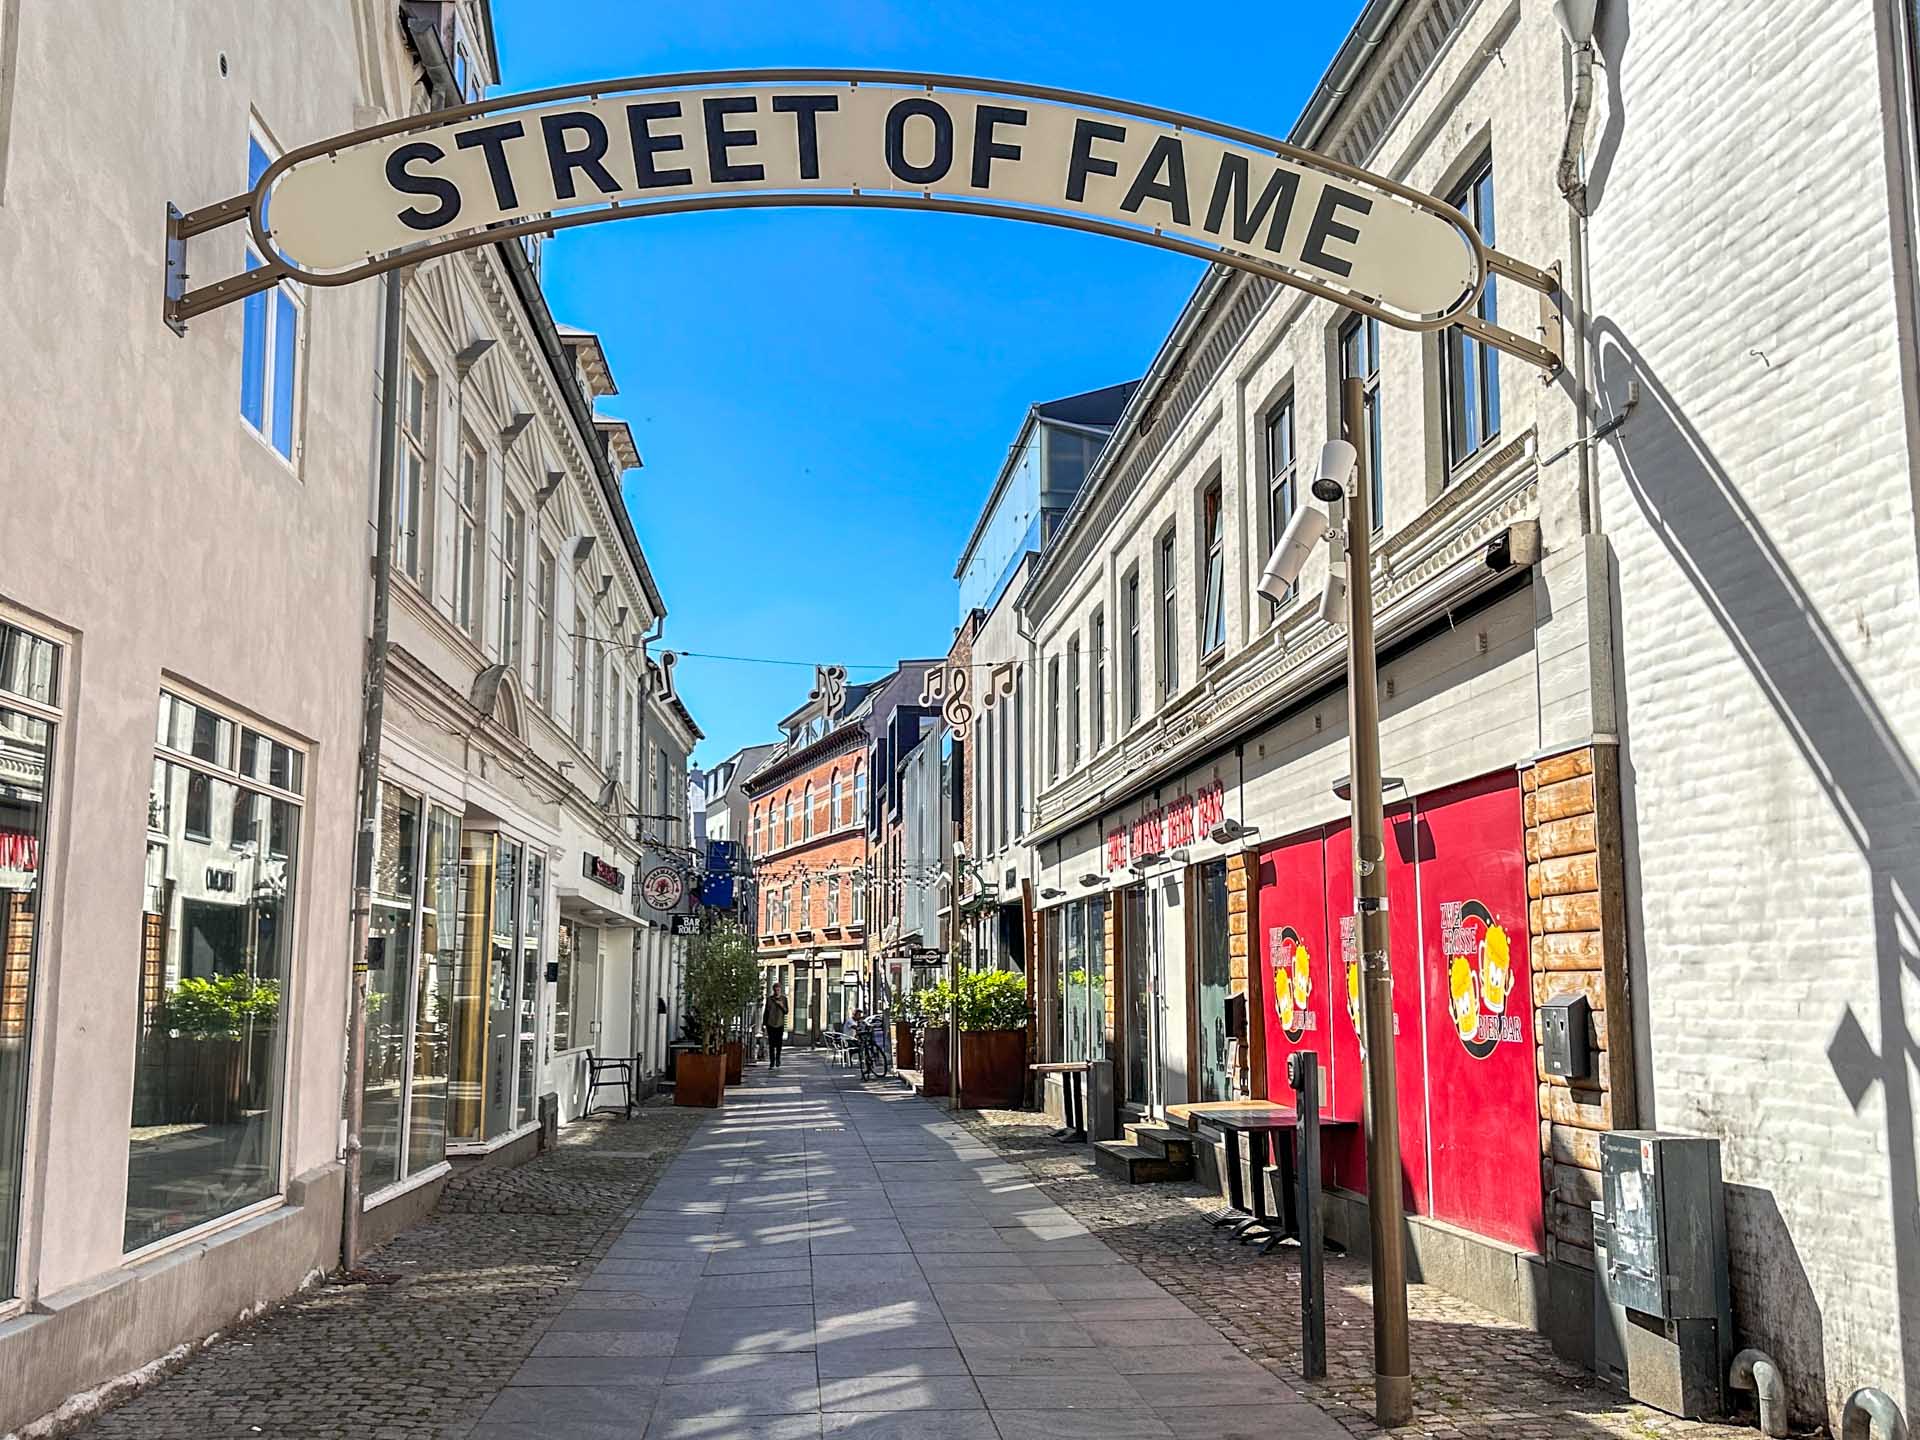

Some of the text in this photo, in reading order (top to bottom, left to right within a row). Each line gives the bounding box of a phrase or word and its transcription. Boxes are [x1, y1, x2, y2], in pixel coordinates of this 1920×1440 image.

[386, 95, 1373, 277] STREET OF FAME
[682, 917, 700, 927] BAR
[1440, 902, 1462, 928] ZWEI
[677, 925, 700, 935] ROUG
[1479, 1015, 1523, 1043] BIER BAR
